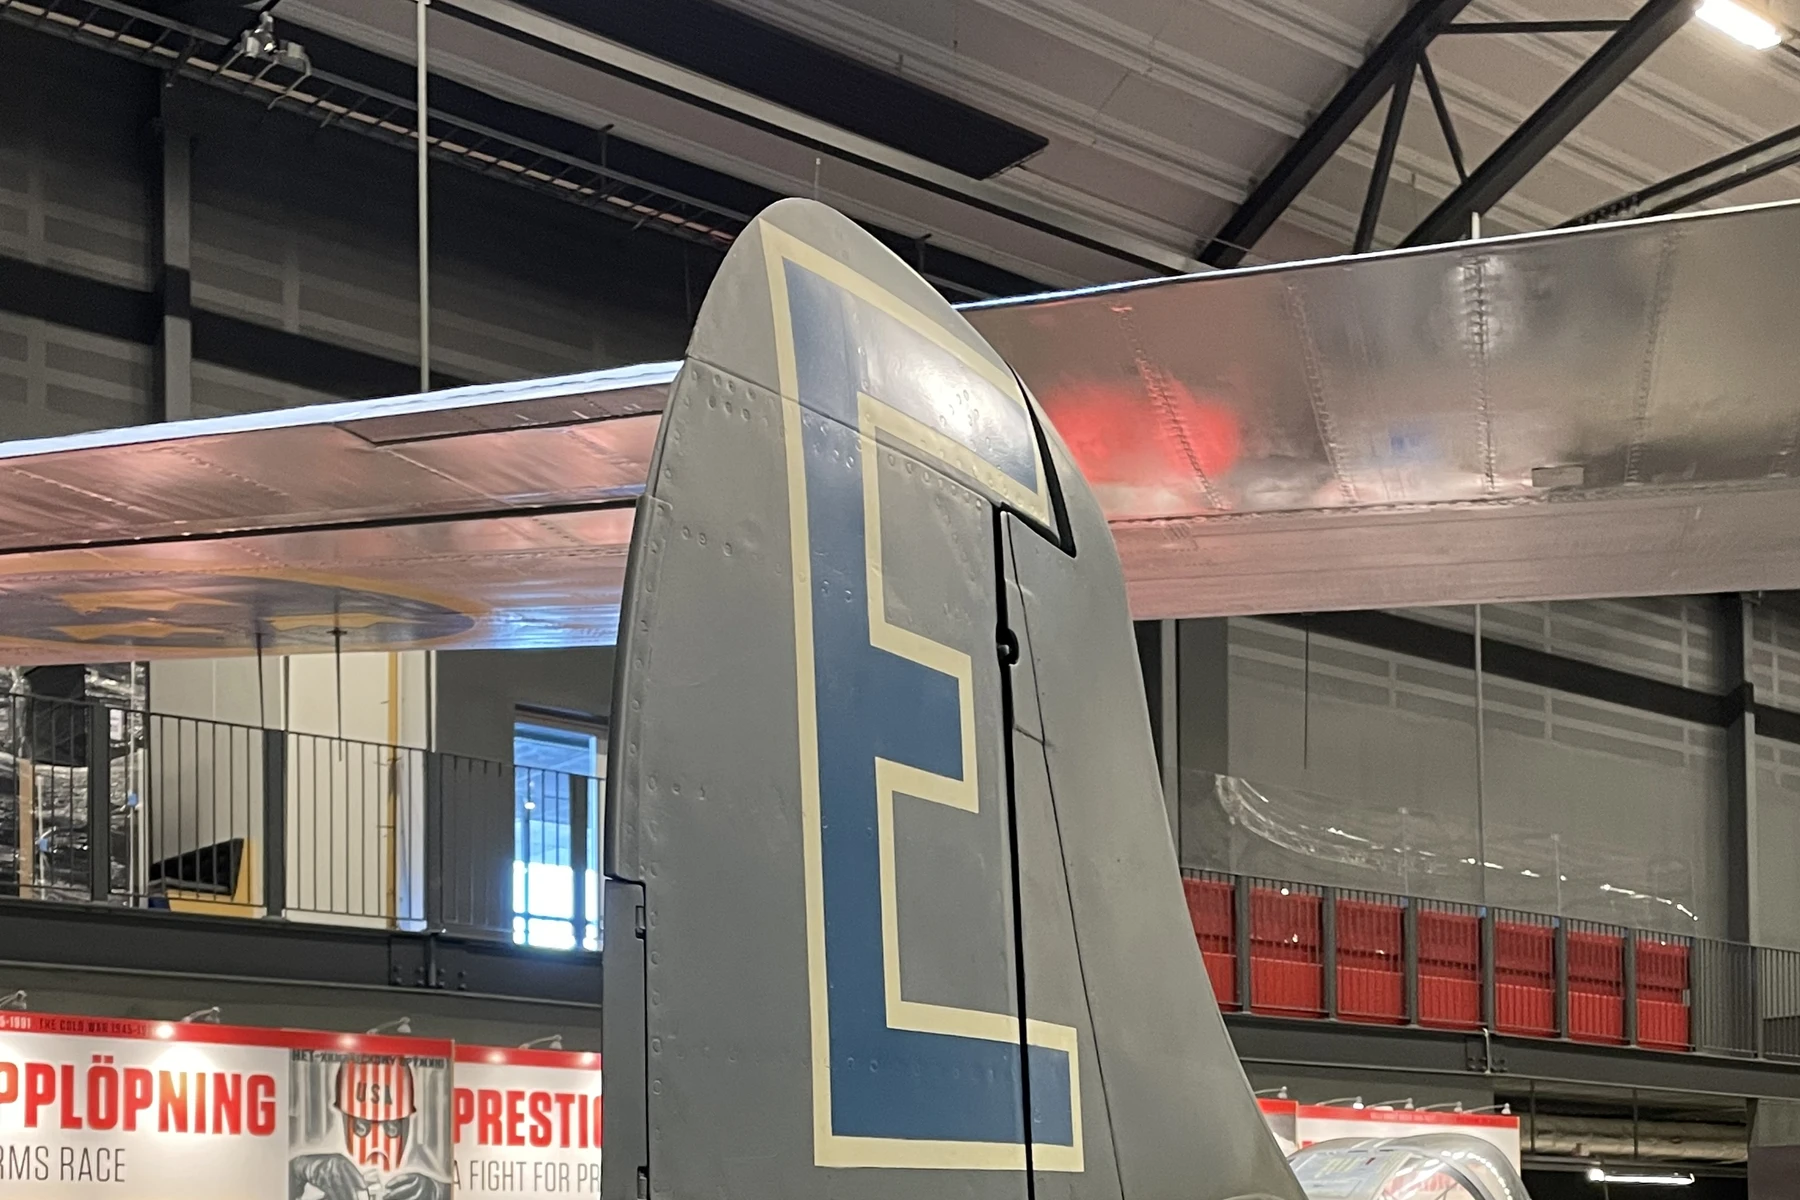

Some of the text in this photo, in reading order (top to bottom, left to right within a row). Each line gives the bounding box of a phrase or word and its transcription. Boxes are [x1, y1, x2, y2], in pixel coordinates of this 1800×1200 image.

[760, 218, 1085, 1171] E
[40, 1017, 56, 1030] THE
[60, 1019, 84, 1032] COLD
[356, 1081, 393, 1106] USA
[60, 1146, 126, 1183] RACE
[470, 1160, 527, 1192] FIGHT
[534, 1161, 570, 1192] FOR
